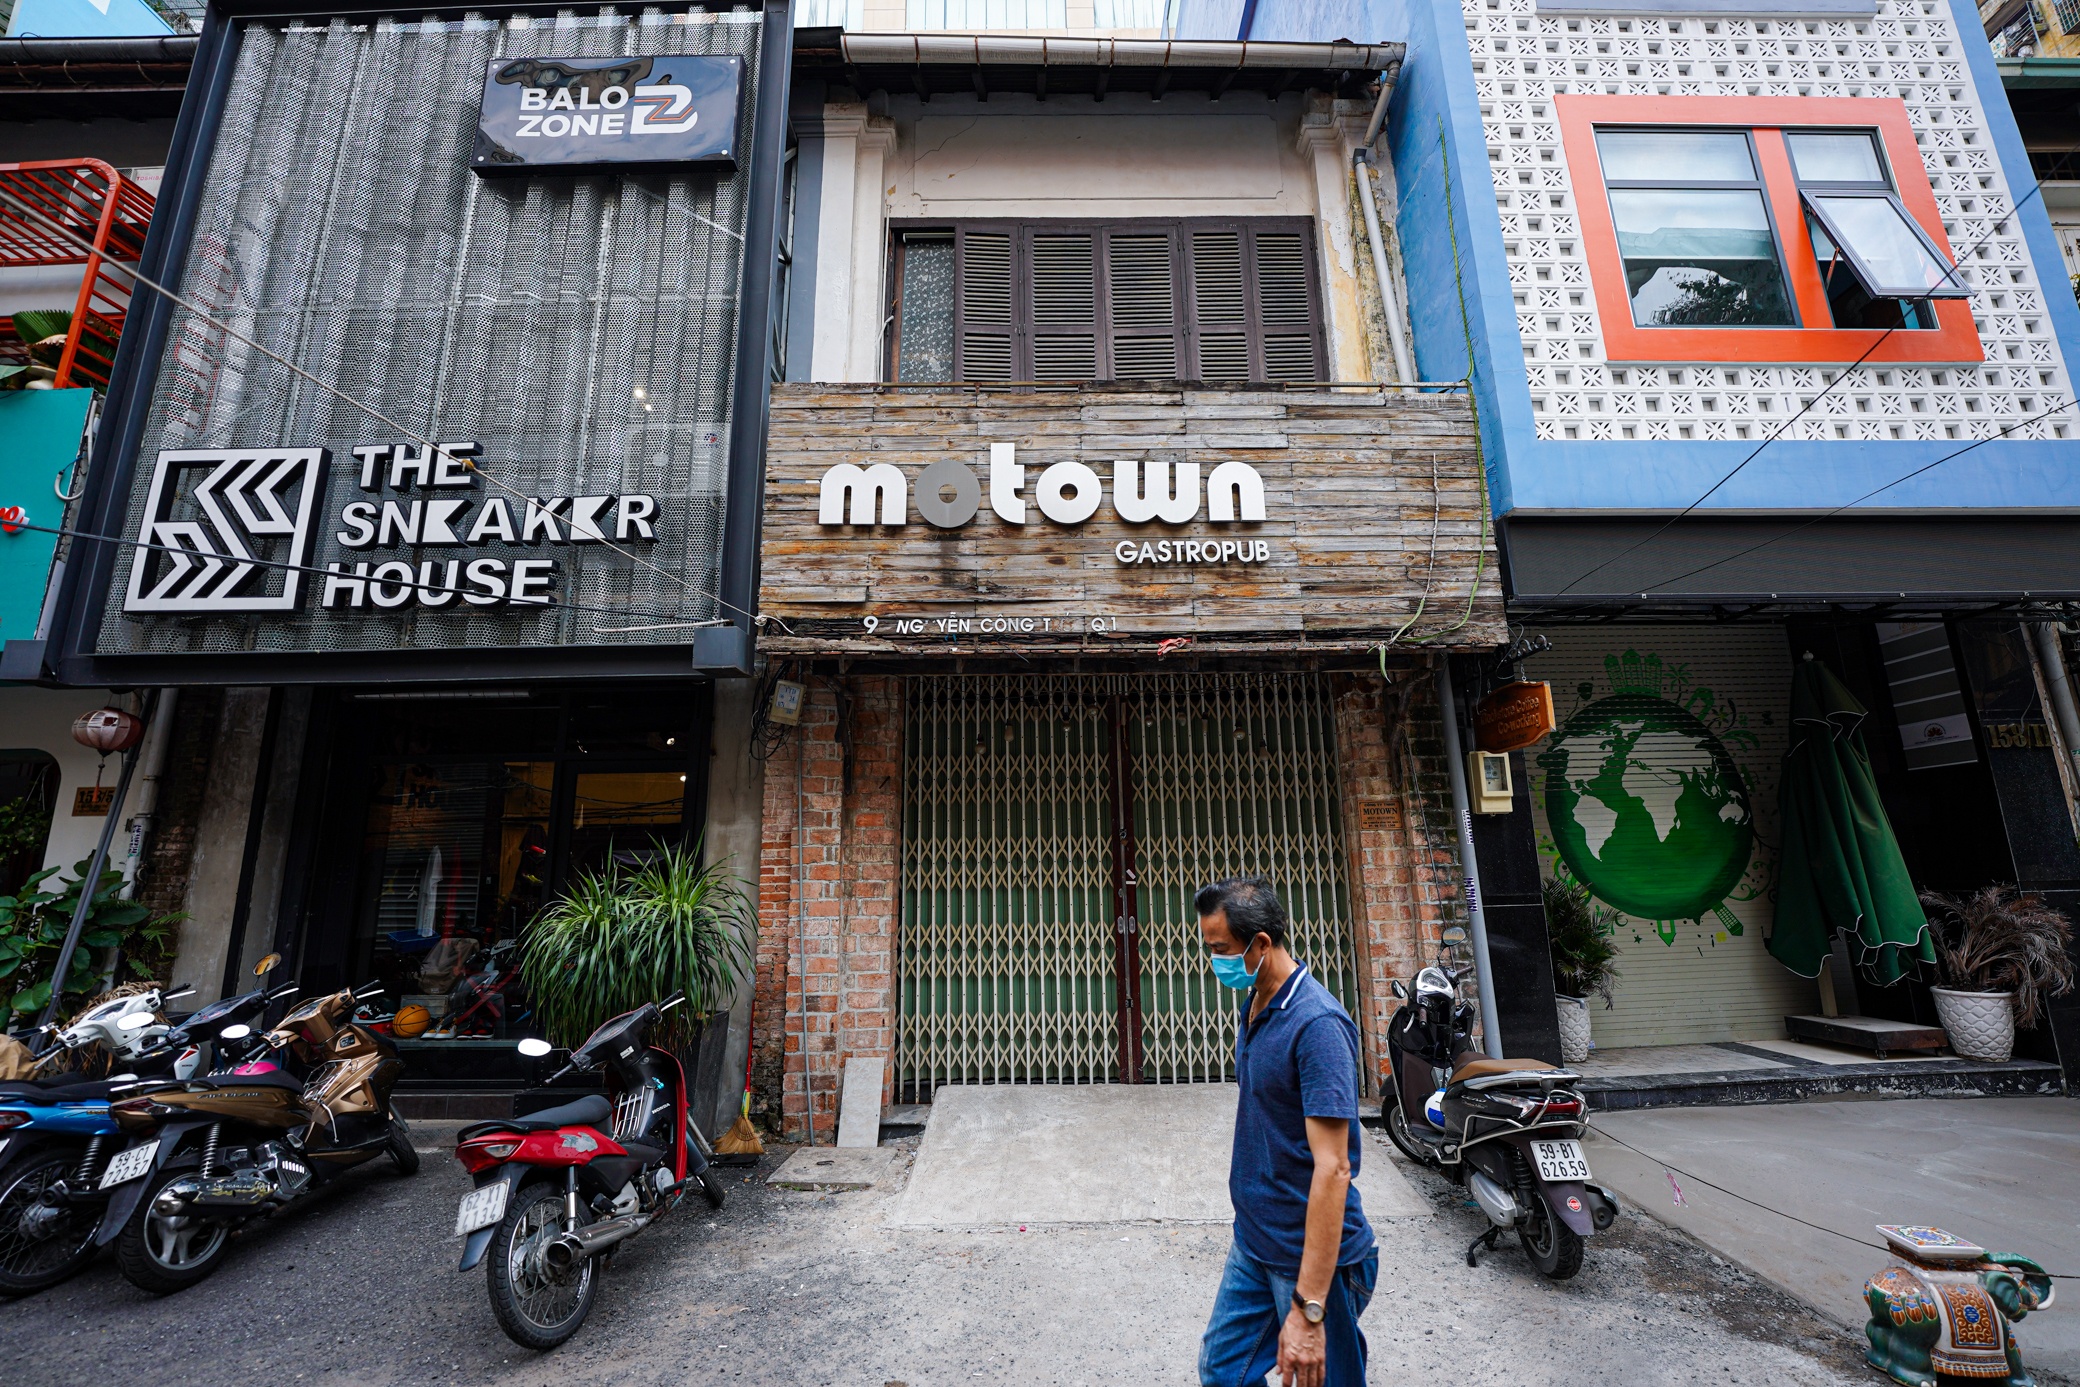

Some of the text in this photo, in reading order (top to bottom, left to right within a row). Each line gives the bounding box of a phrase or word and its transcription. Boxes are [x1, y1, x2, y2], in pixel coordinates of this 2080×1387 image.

[520, 86, 629, 111] BALO
[515, 114, 625, 137] ZONE
[353, 441, 479, 490] THE
[818, 442, 1267, 528] motown
[1115, 540, 1271, 564] GASTROPUB
[321, 557, 555, 608] HOUSE
[863, 615, 879, 634] 9
[896, 611, 970, 634] NGYỄN
[980, 613, 1035, 633] CÔNG
[1091, 616, 1117, 633] Q.1
[1363, 807, 1398, 815] MOTOWN
[115, 1145, 150, 1169] 59-C1
[1539, 1143, 1576, 1160] 59-B1
[103, 1159, 149, 1187] 722.57
[1541, 1160, 1588, 1178] 626.59
